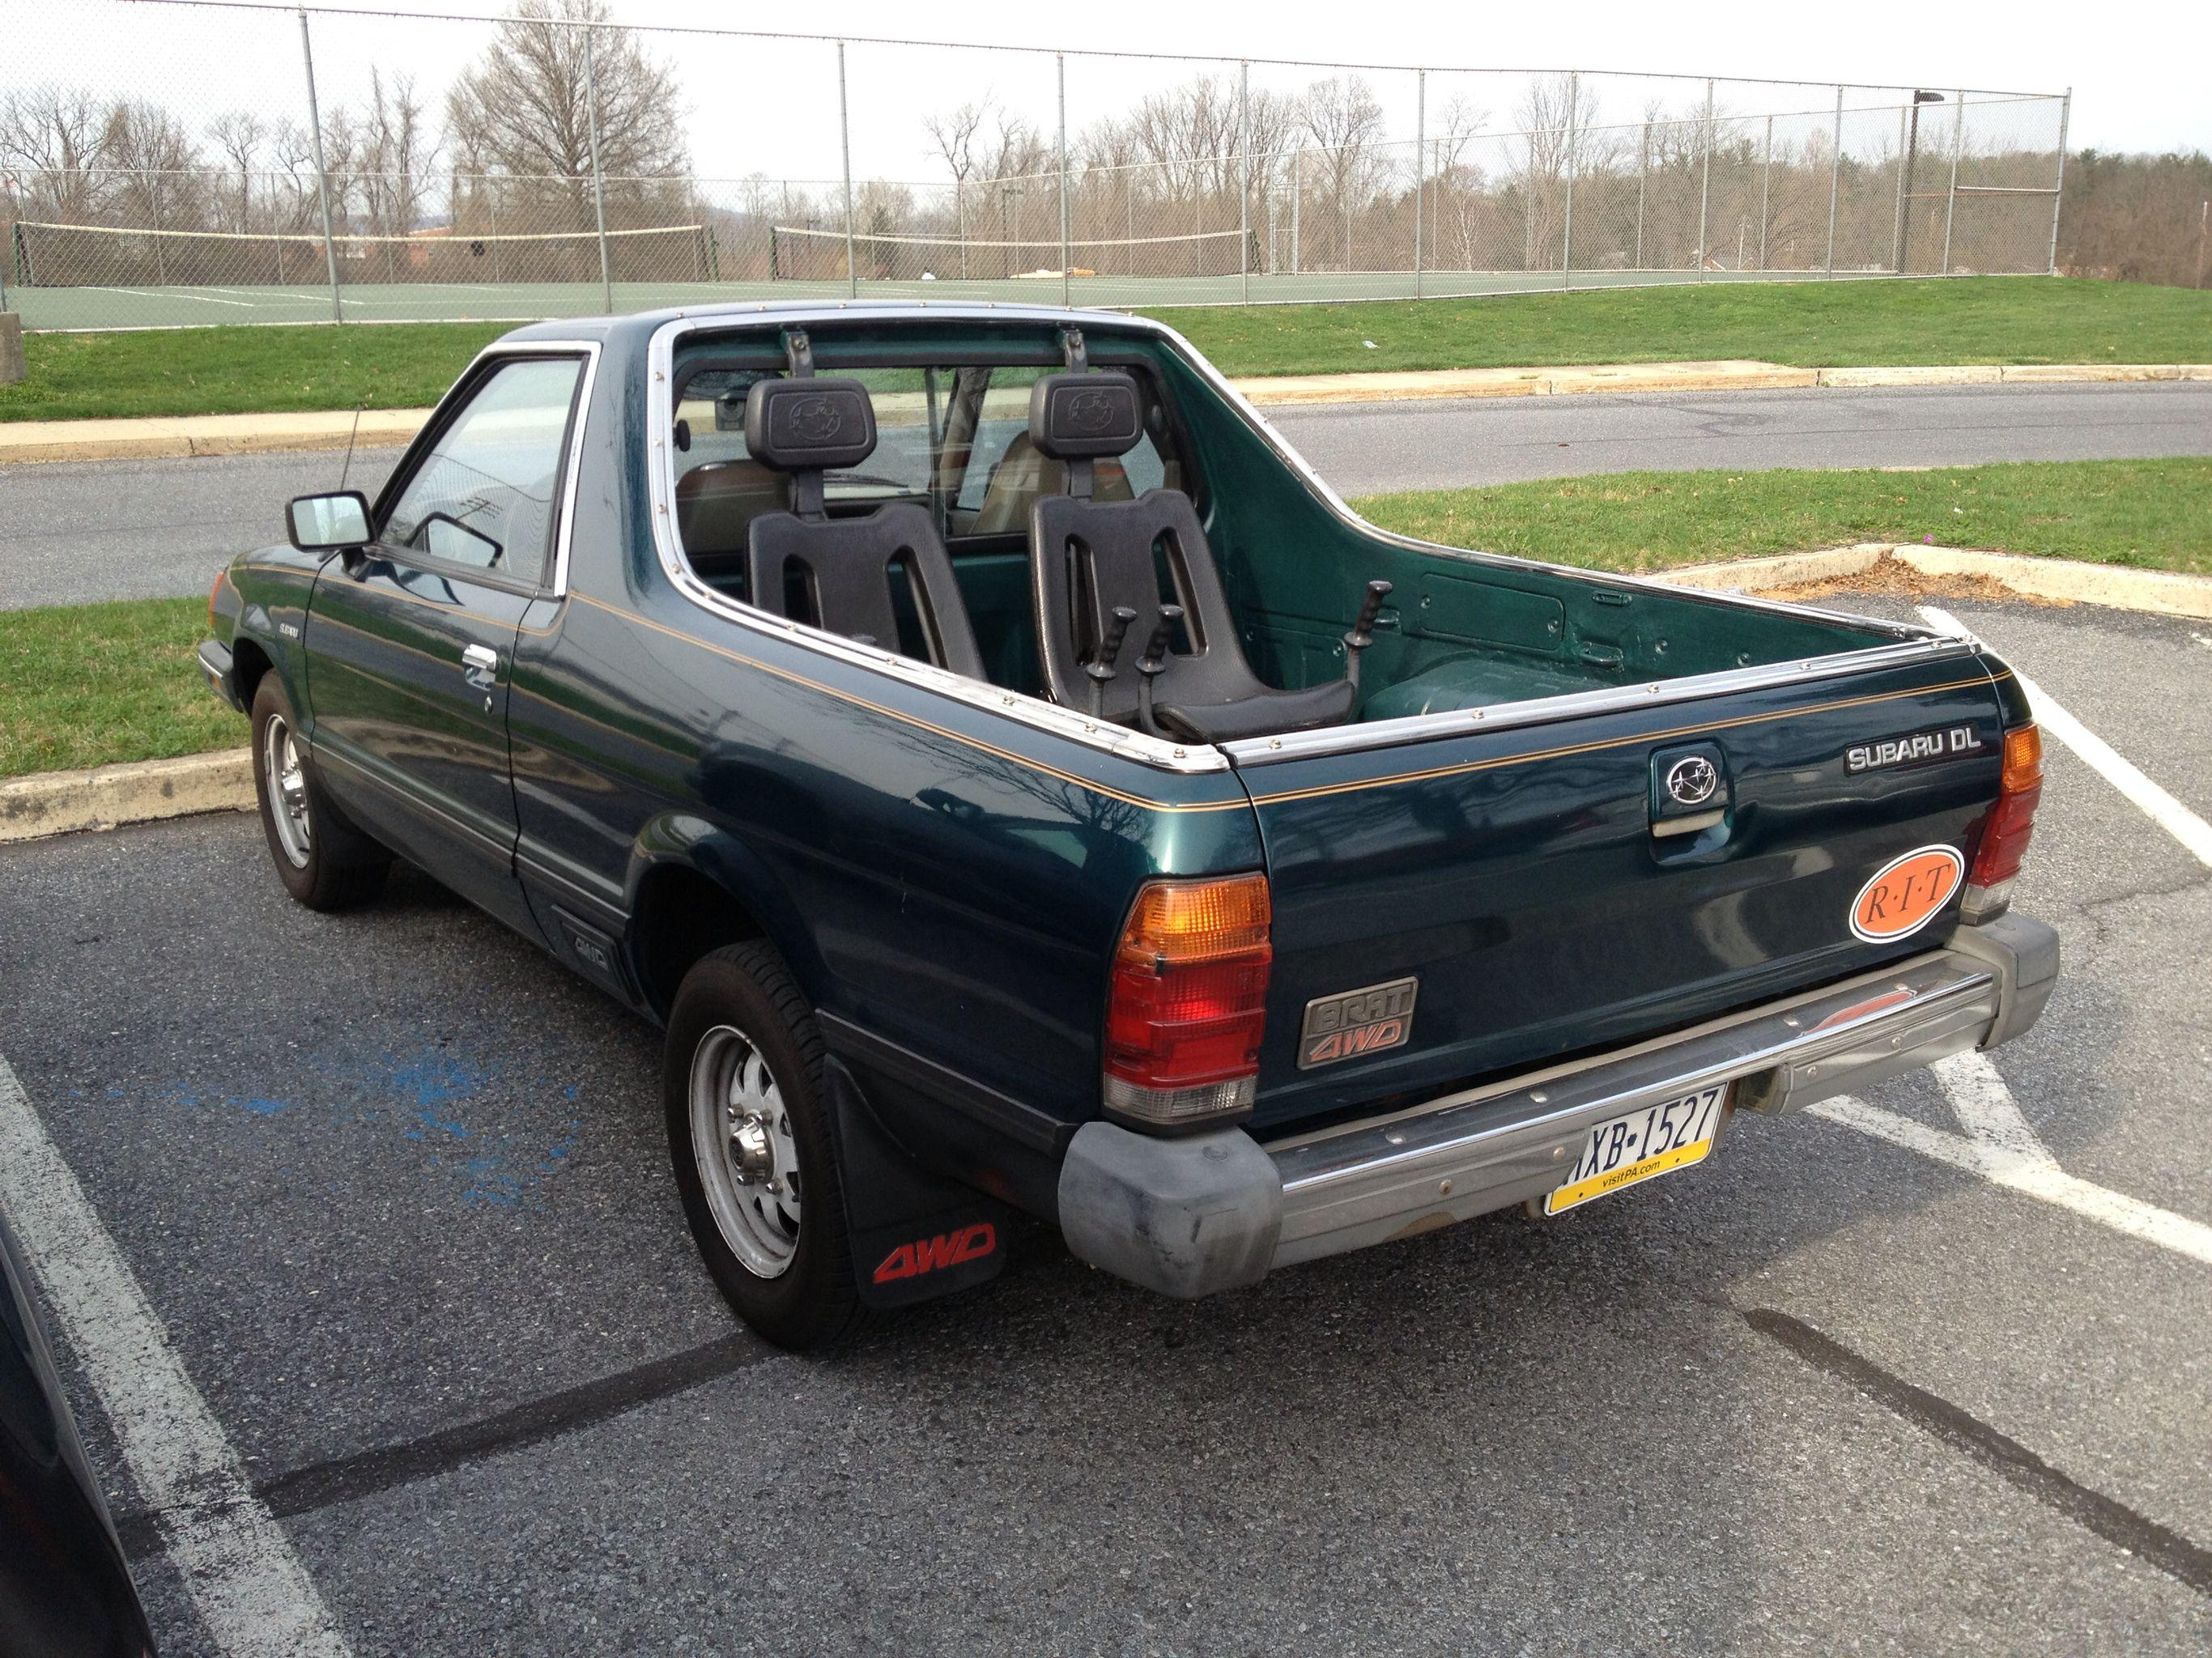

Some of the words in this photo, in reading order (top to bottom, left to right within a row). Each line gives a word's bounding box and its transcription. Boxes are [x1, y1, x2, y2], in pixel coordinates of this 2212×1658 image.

[1848, 733, 1943, 770] SUBARU
[1950, 728, 1981, 752] DL
[1315, 984, 1412, 1034] BRAT
[1308, 1018, 1402, 1062] 4WD
[1602, 1160, 1661, 1188] visitPA.com
[872, 1222, 997, 1284] 4WD
